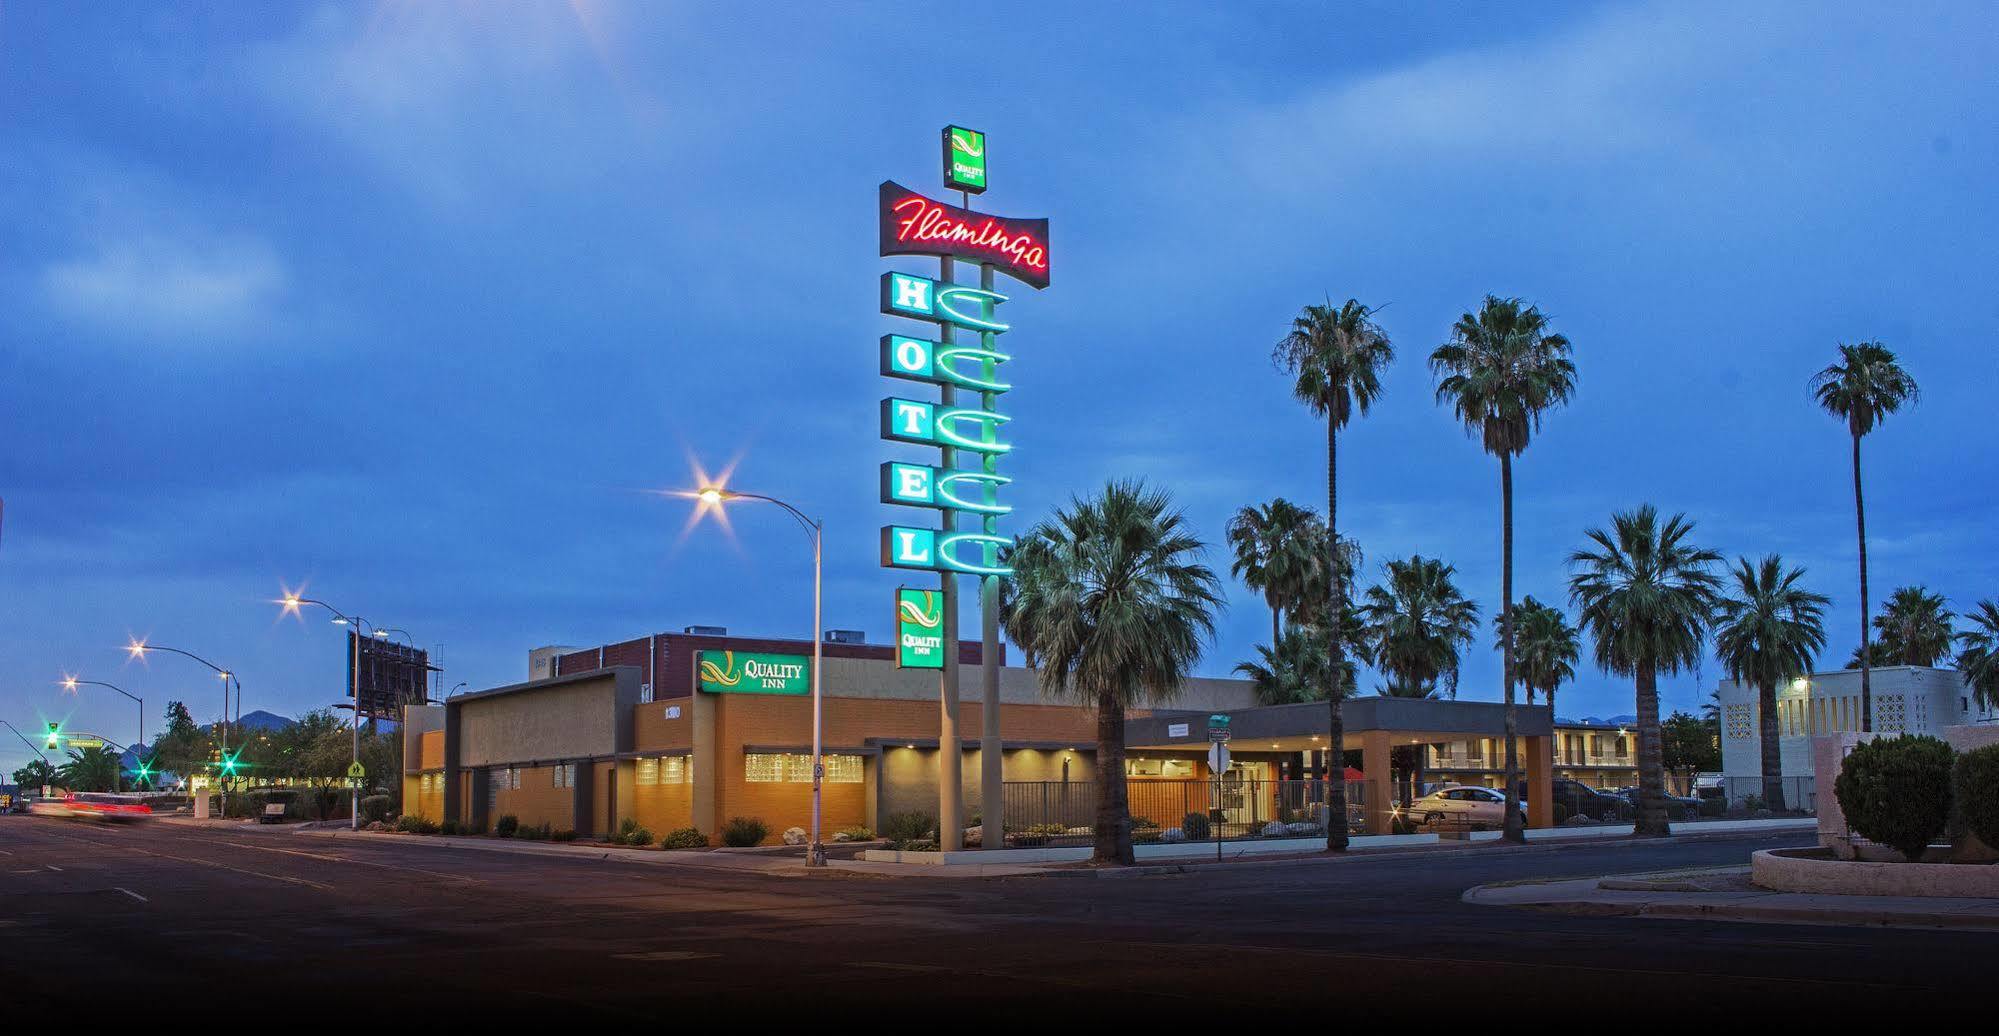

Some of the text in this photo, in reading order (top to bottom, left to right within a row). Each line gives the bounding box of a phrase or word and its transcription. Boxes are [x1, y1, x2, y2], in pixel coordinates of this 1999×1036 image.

[954, 162, 984, 176] QUALITY
[903, 633, 941, 648] QUALITY
[914, 646, 931, 656] INN
[745, 660, 803, 679] QUALITY
[762, 678, 786, 689] INN
